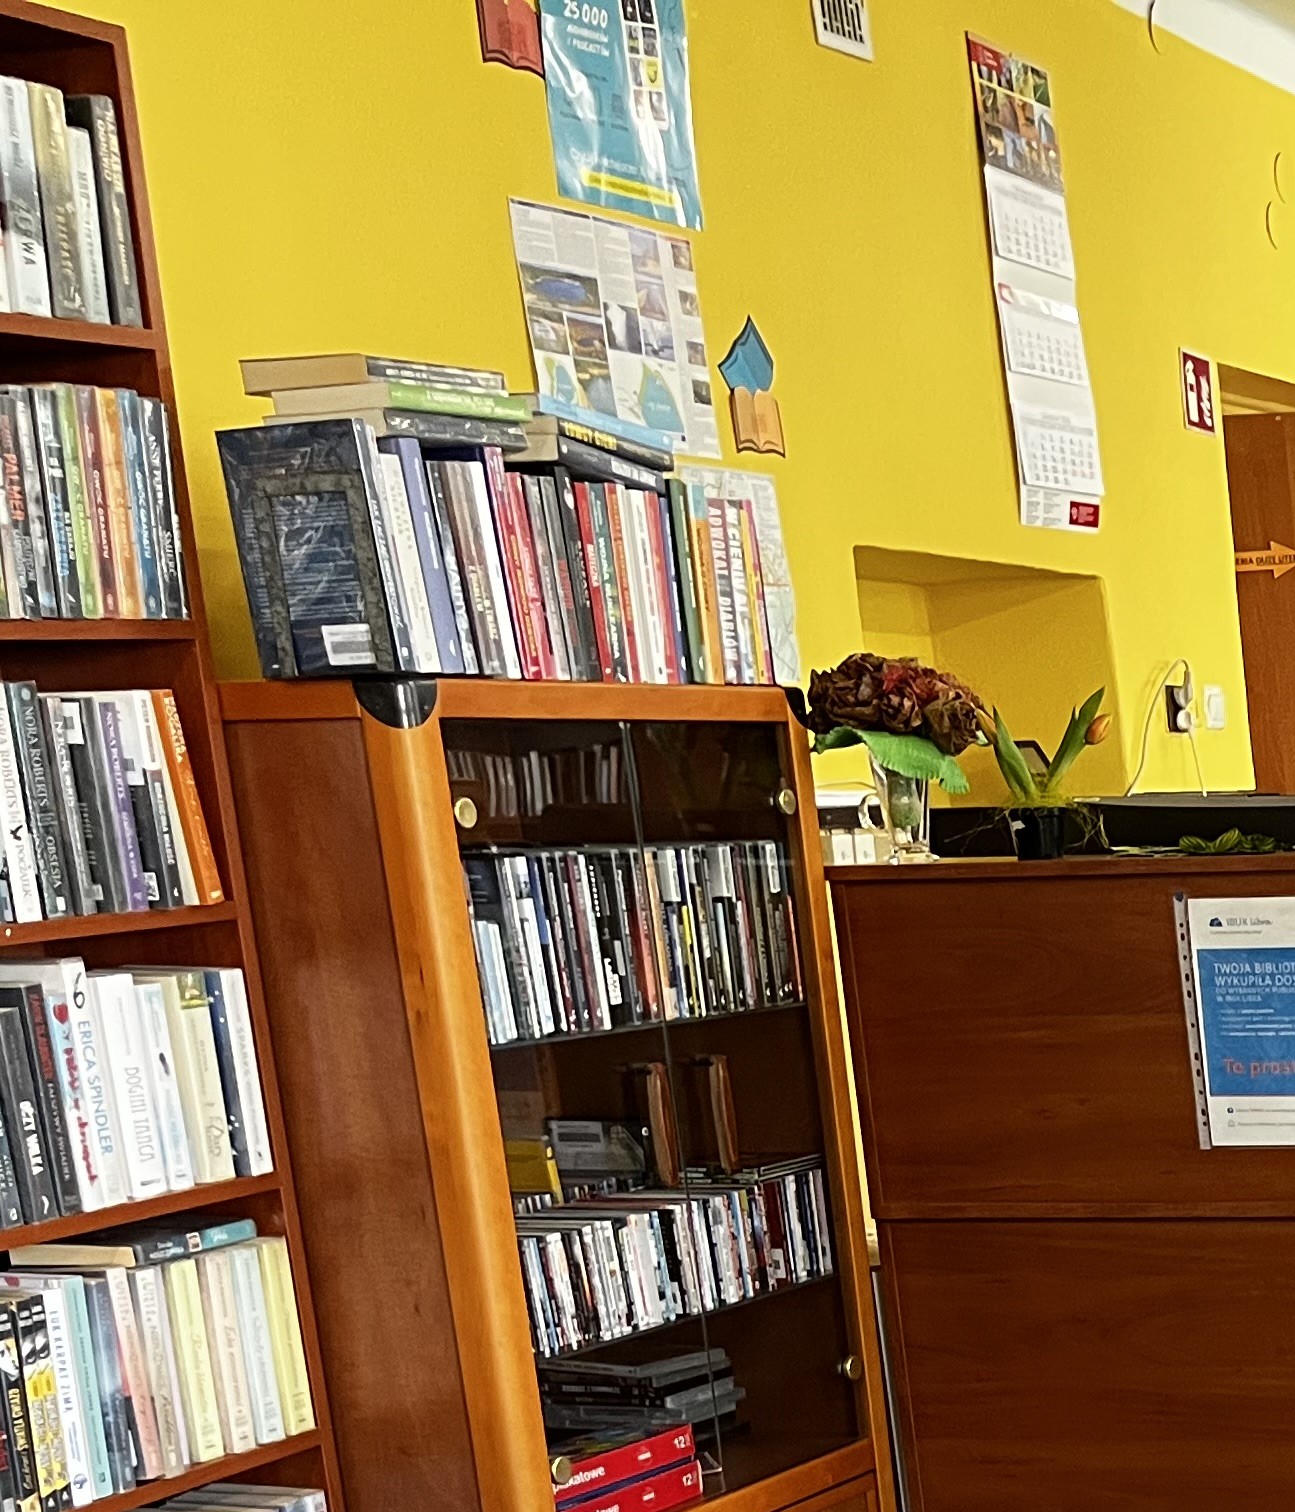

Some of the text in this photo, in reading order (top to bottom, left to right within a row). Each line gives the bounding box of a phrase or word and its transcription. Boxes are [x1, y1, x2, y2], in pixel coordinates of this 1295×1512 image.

[564, 0, 608, 29] 25 000
[2, 451, 25, 522] PALMER
[96, 506, 109, 559] GRANATU
[138, 507, 151, 559] GRANATU
[725, 506, 737, 526] W
[597, 537, 609, 579] WOJNA
[0, 748, 20, 809] ROBERTS
[21, 704, 62, 888] NORA ROBERTS OBSESJA
[1214, 962, 1250, 974] TWOJA
[1214, 976, 1272, 986] WYKUPIŁA
[77, 1019, 98, 1071] ERICA
[1223, 1058, 1244, 1074] To
[18, 1099, 37, 1132] OCZY
[86, 1075, 113, 1155] SPINDLER
[49, 1310, 73, 1413] ŁUK KARPAT ZIMĄ
[673, 1435, 685, 1449] 12
[552, 1466, 605, 1495] pkatowe
[682, 1473, 692, 1486] 12
